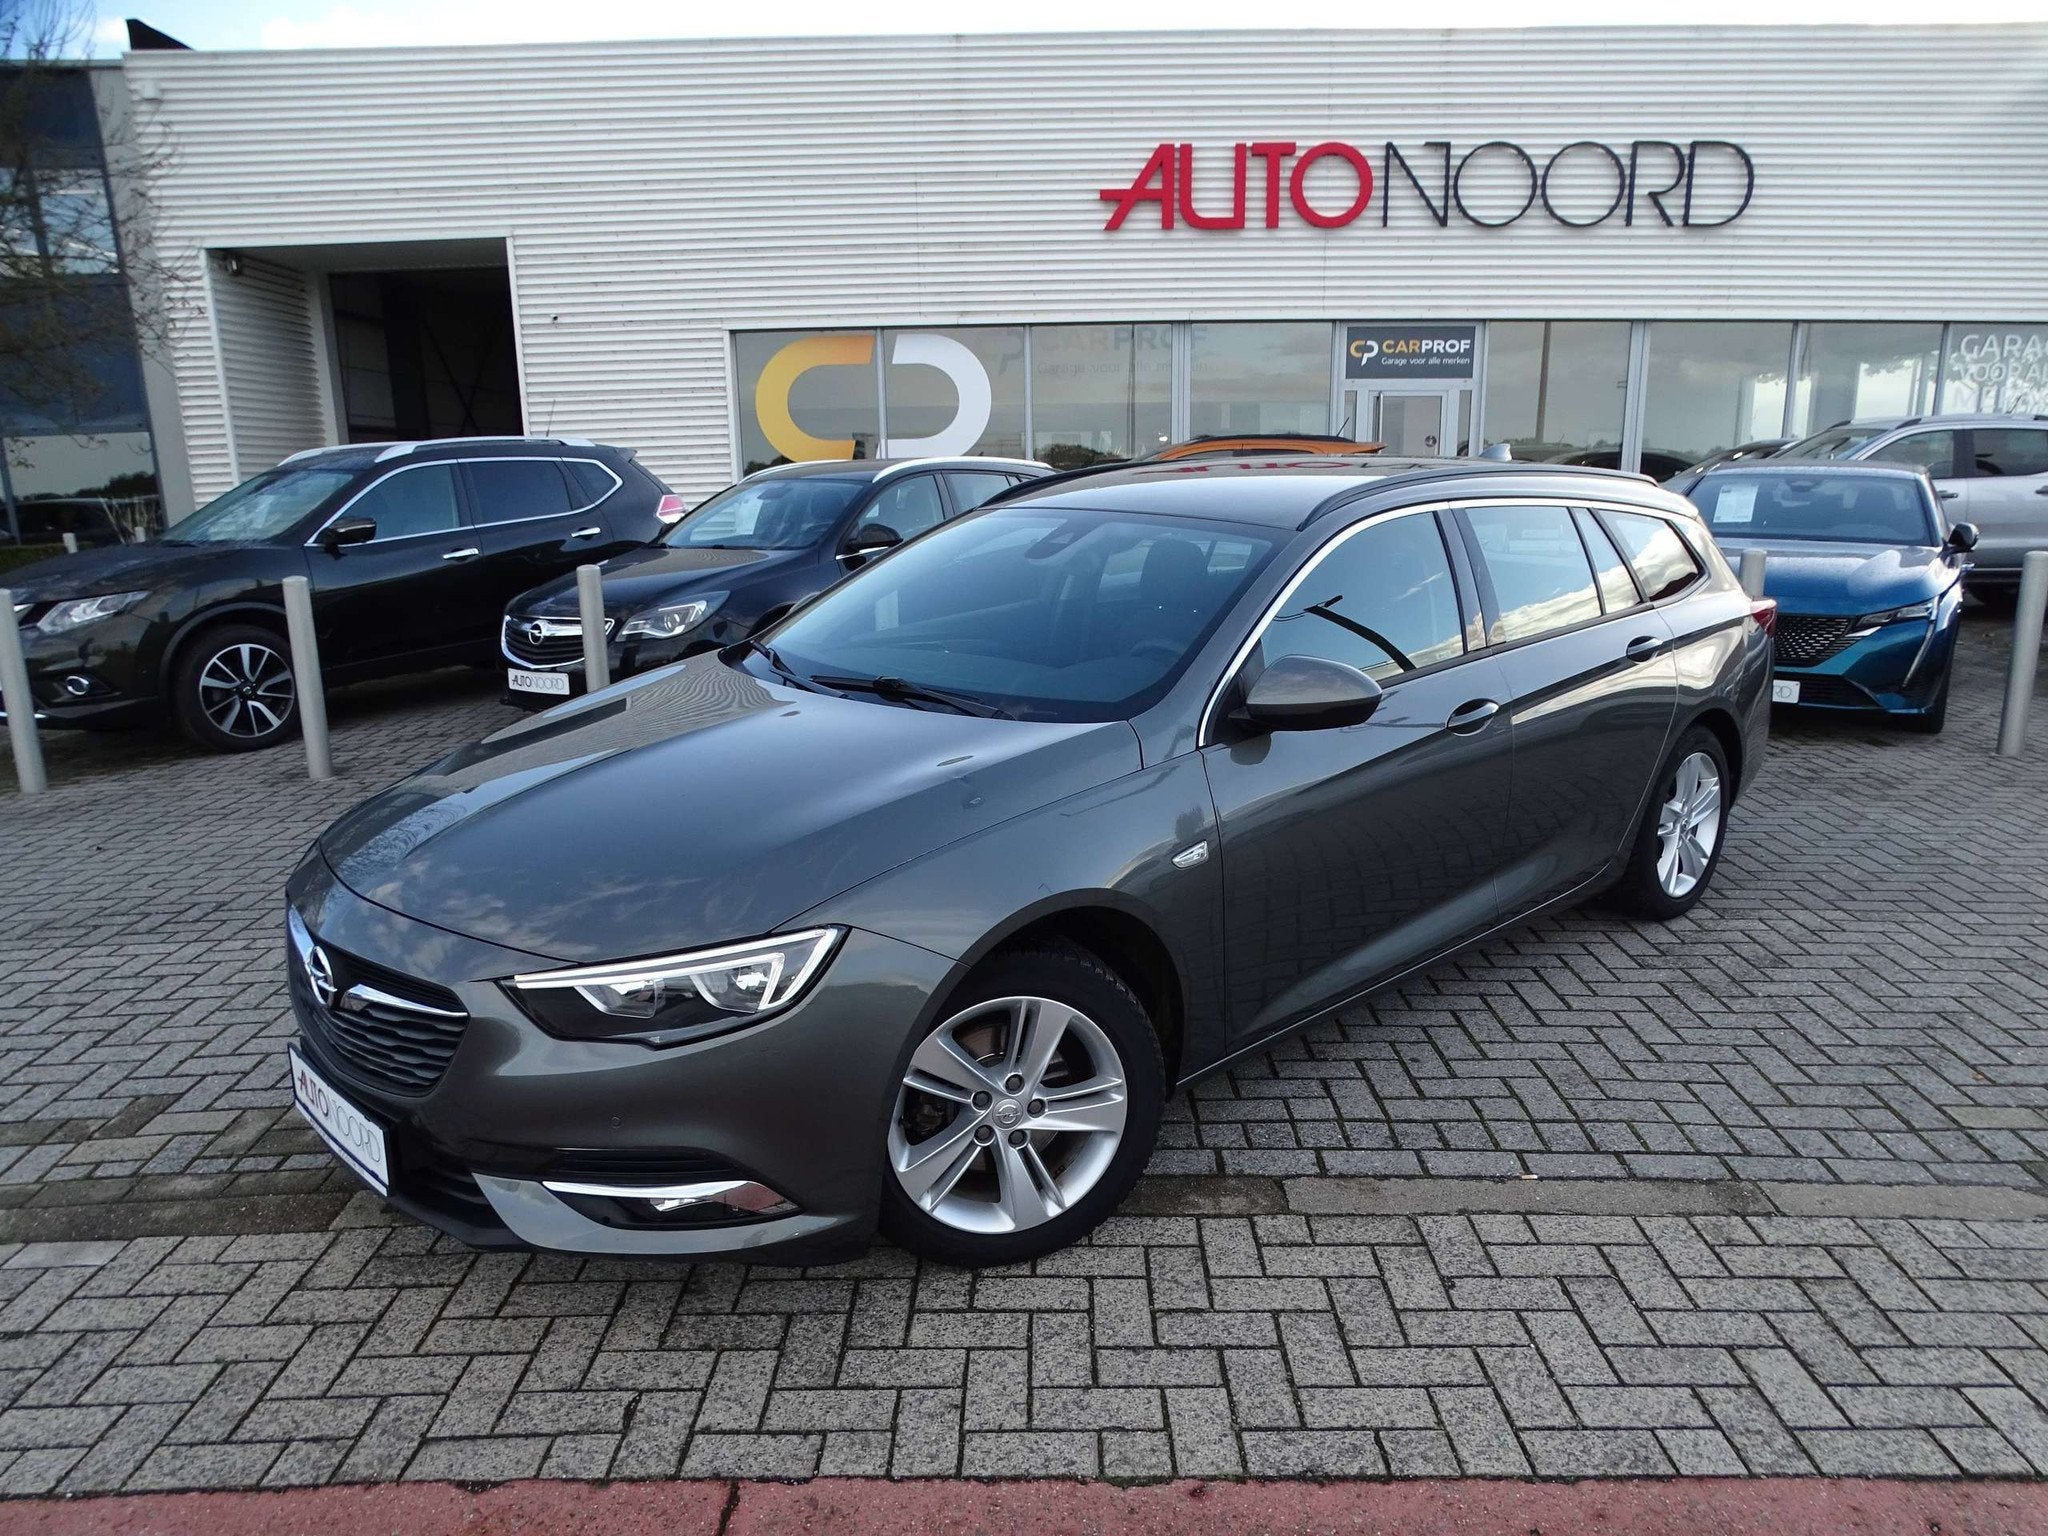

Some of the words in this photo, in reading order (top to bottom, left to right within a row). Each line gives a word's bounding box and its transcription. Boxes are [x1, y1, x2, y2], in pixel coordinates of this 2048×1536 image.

[1382, 339, 1471, 353] CARPROF
[1381, 356, 1408, 366] Garage
[1428, 356, 1441, 365] alle
[1442, 356, 1470, 365] merken
